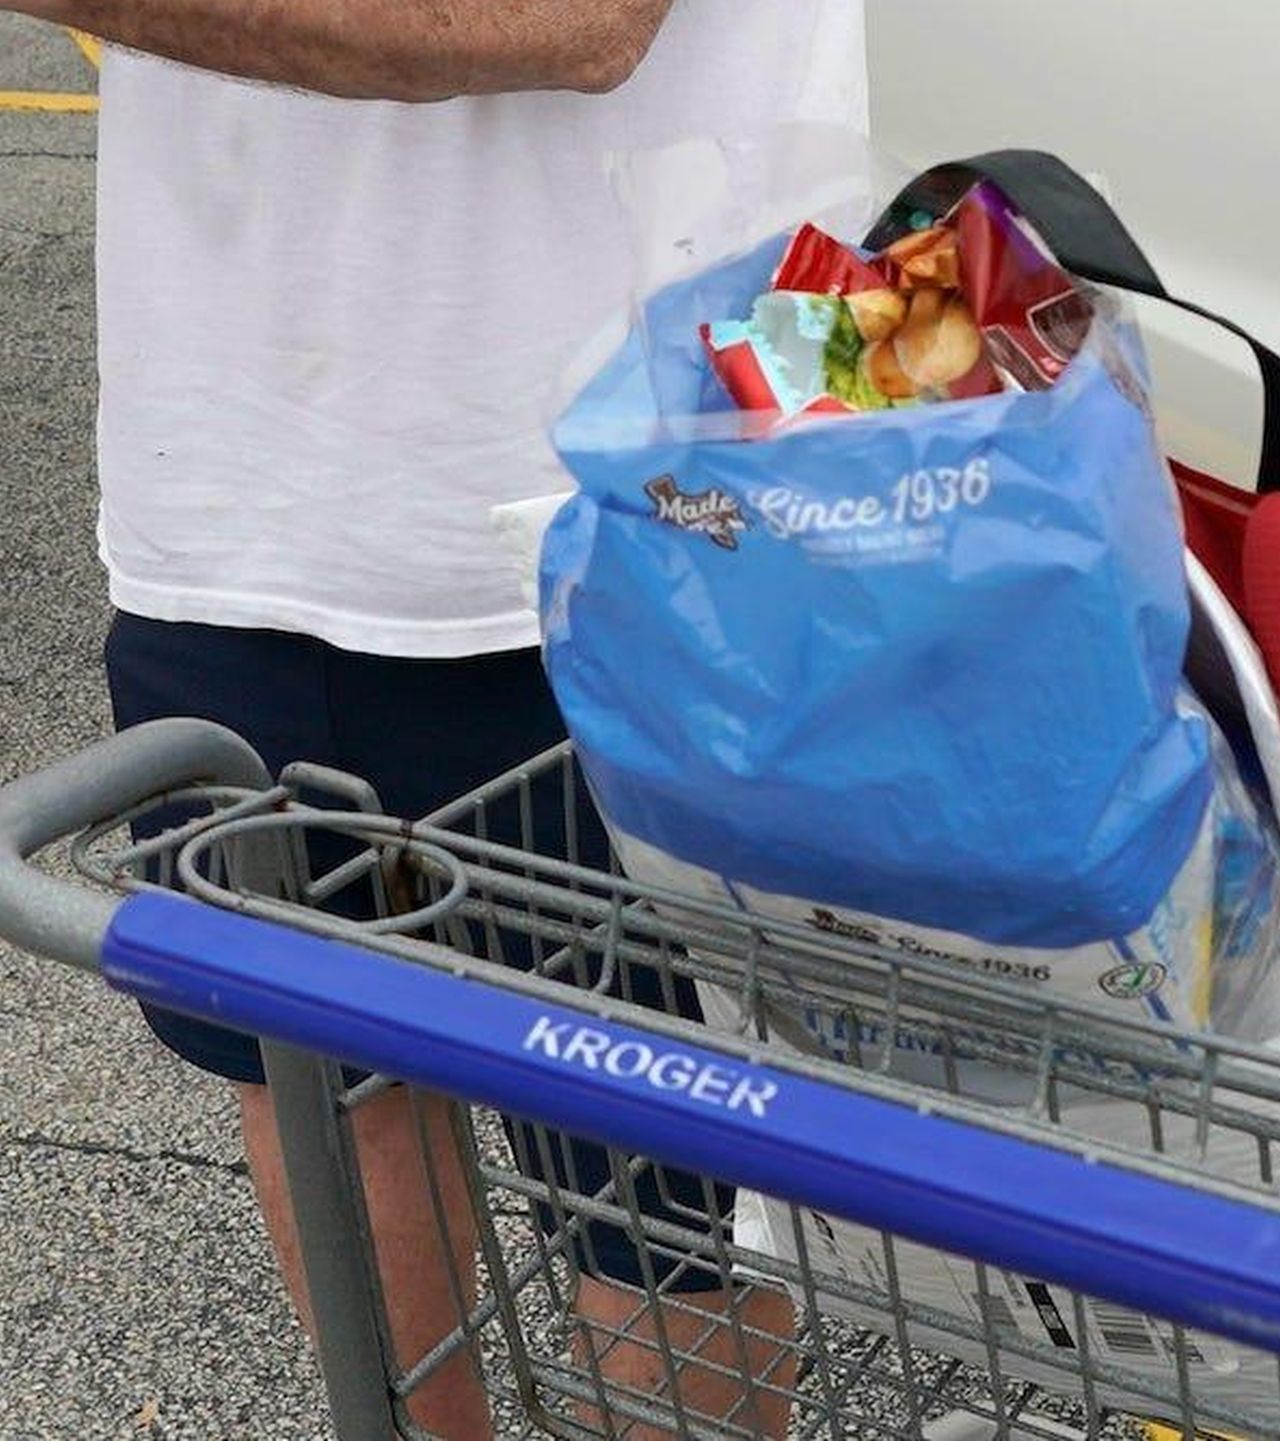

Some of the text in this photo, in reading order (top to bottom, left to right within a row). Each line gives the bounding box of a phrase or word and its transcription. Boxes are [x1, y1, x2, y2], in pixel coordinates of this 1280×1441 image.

[657, 489, 739, 526] Made
[746, 457, 990, 539] Since 1936
[523, 1015, 779, 1118] KROGER
